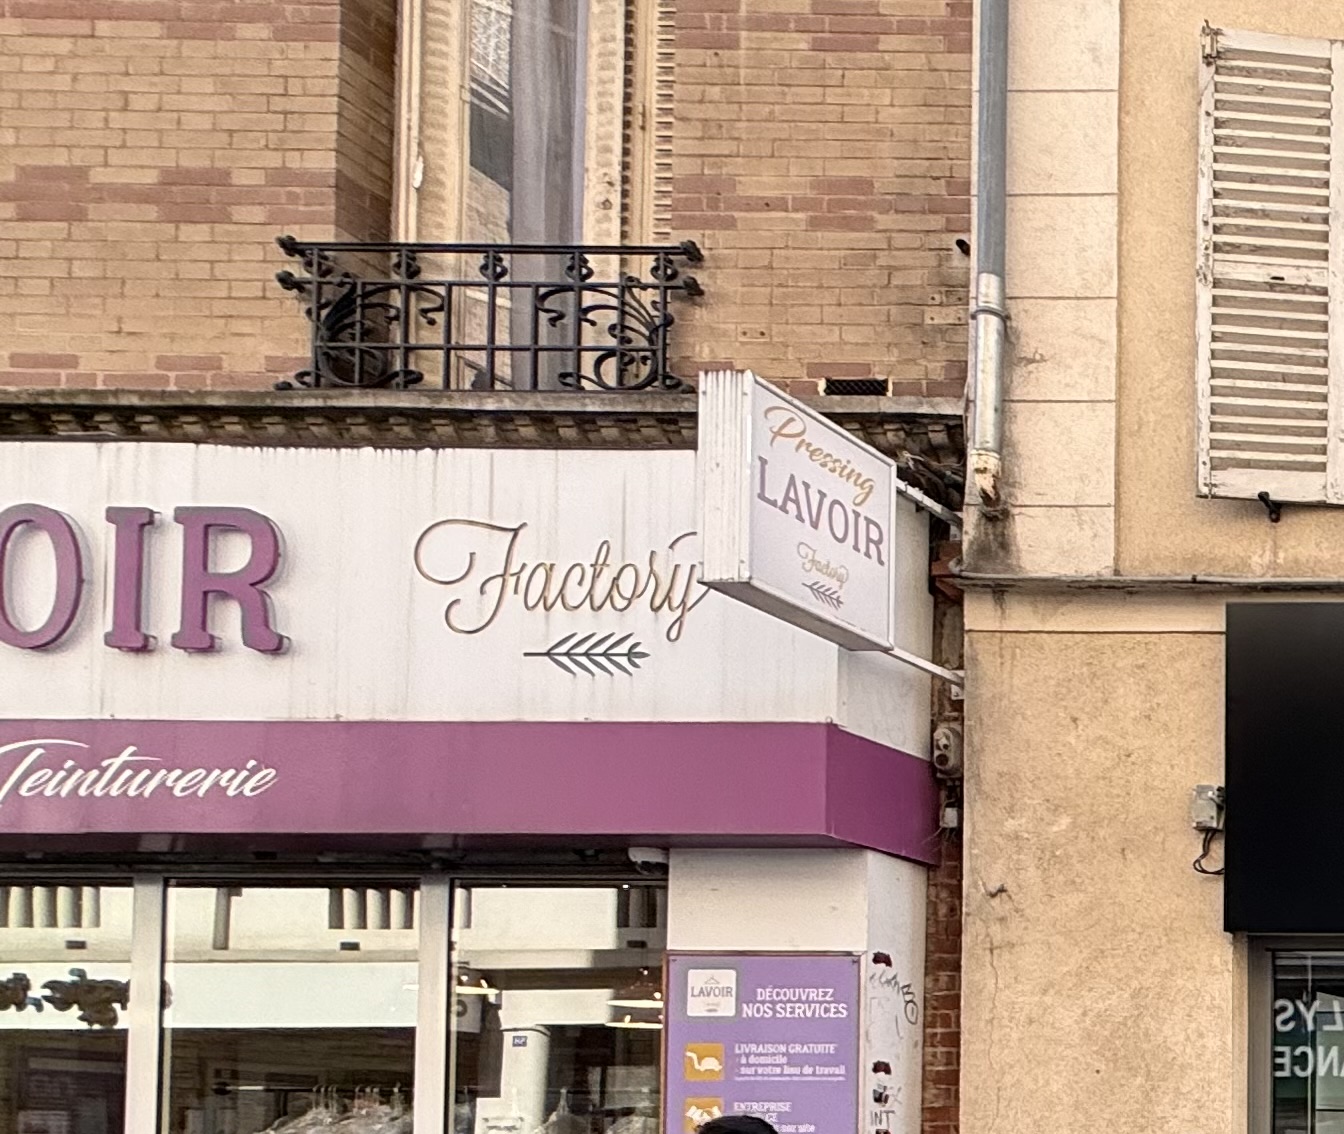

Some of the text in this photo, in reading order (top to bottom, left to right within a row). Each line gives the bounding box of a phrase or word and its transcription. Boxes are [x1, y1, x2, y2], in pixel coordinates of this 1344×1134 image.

[764, 405, 876, 506] Pressing
[757, 456, 885, 566] LAVOIR
[414, 518, 710, 642] Factory
[0, 738, 278, 798] Teinturerie
[691, 986, 733, 998] LAVOIR
[756, 985, 835, 1001] DÉCOUVREZ
[742, 1003, 848, 1018] NOS SERVICES
[735, 1043, 787, 1054] LIVRAISON
[734, 1102, 792, 1112] ENTREPRISE
